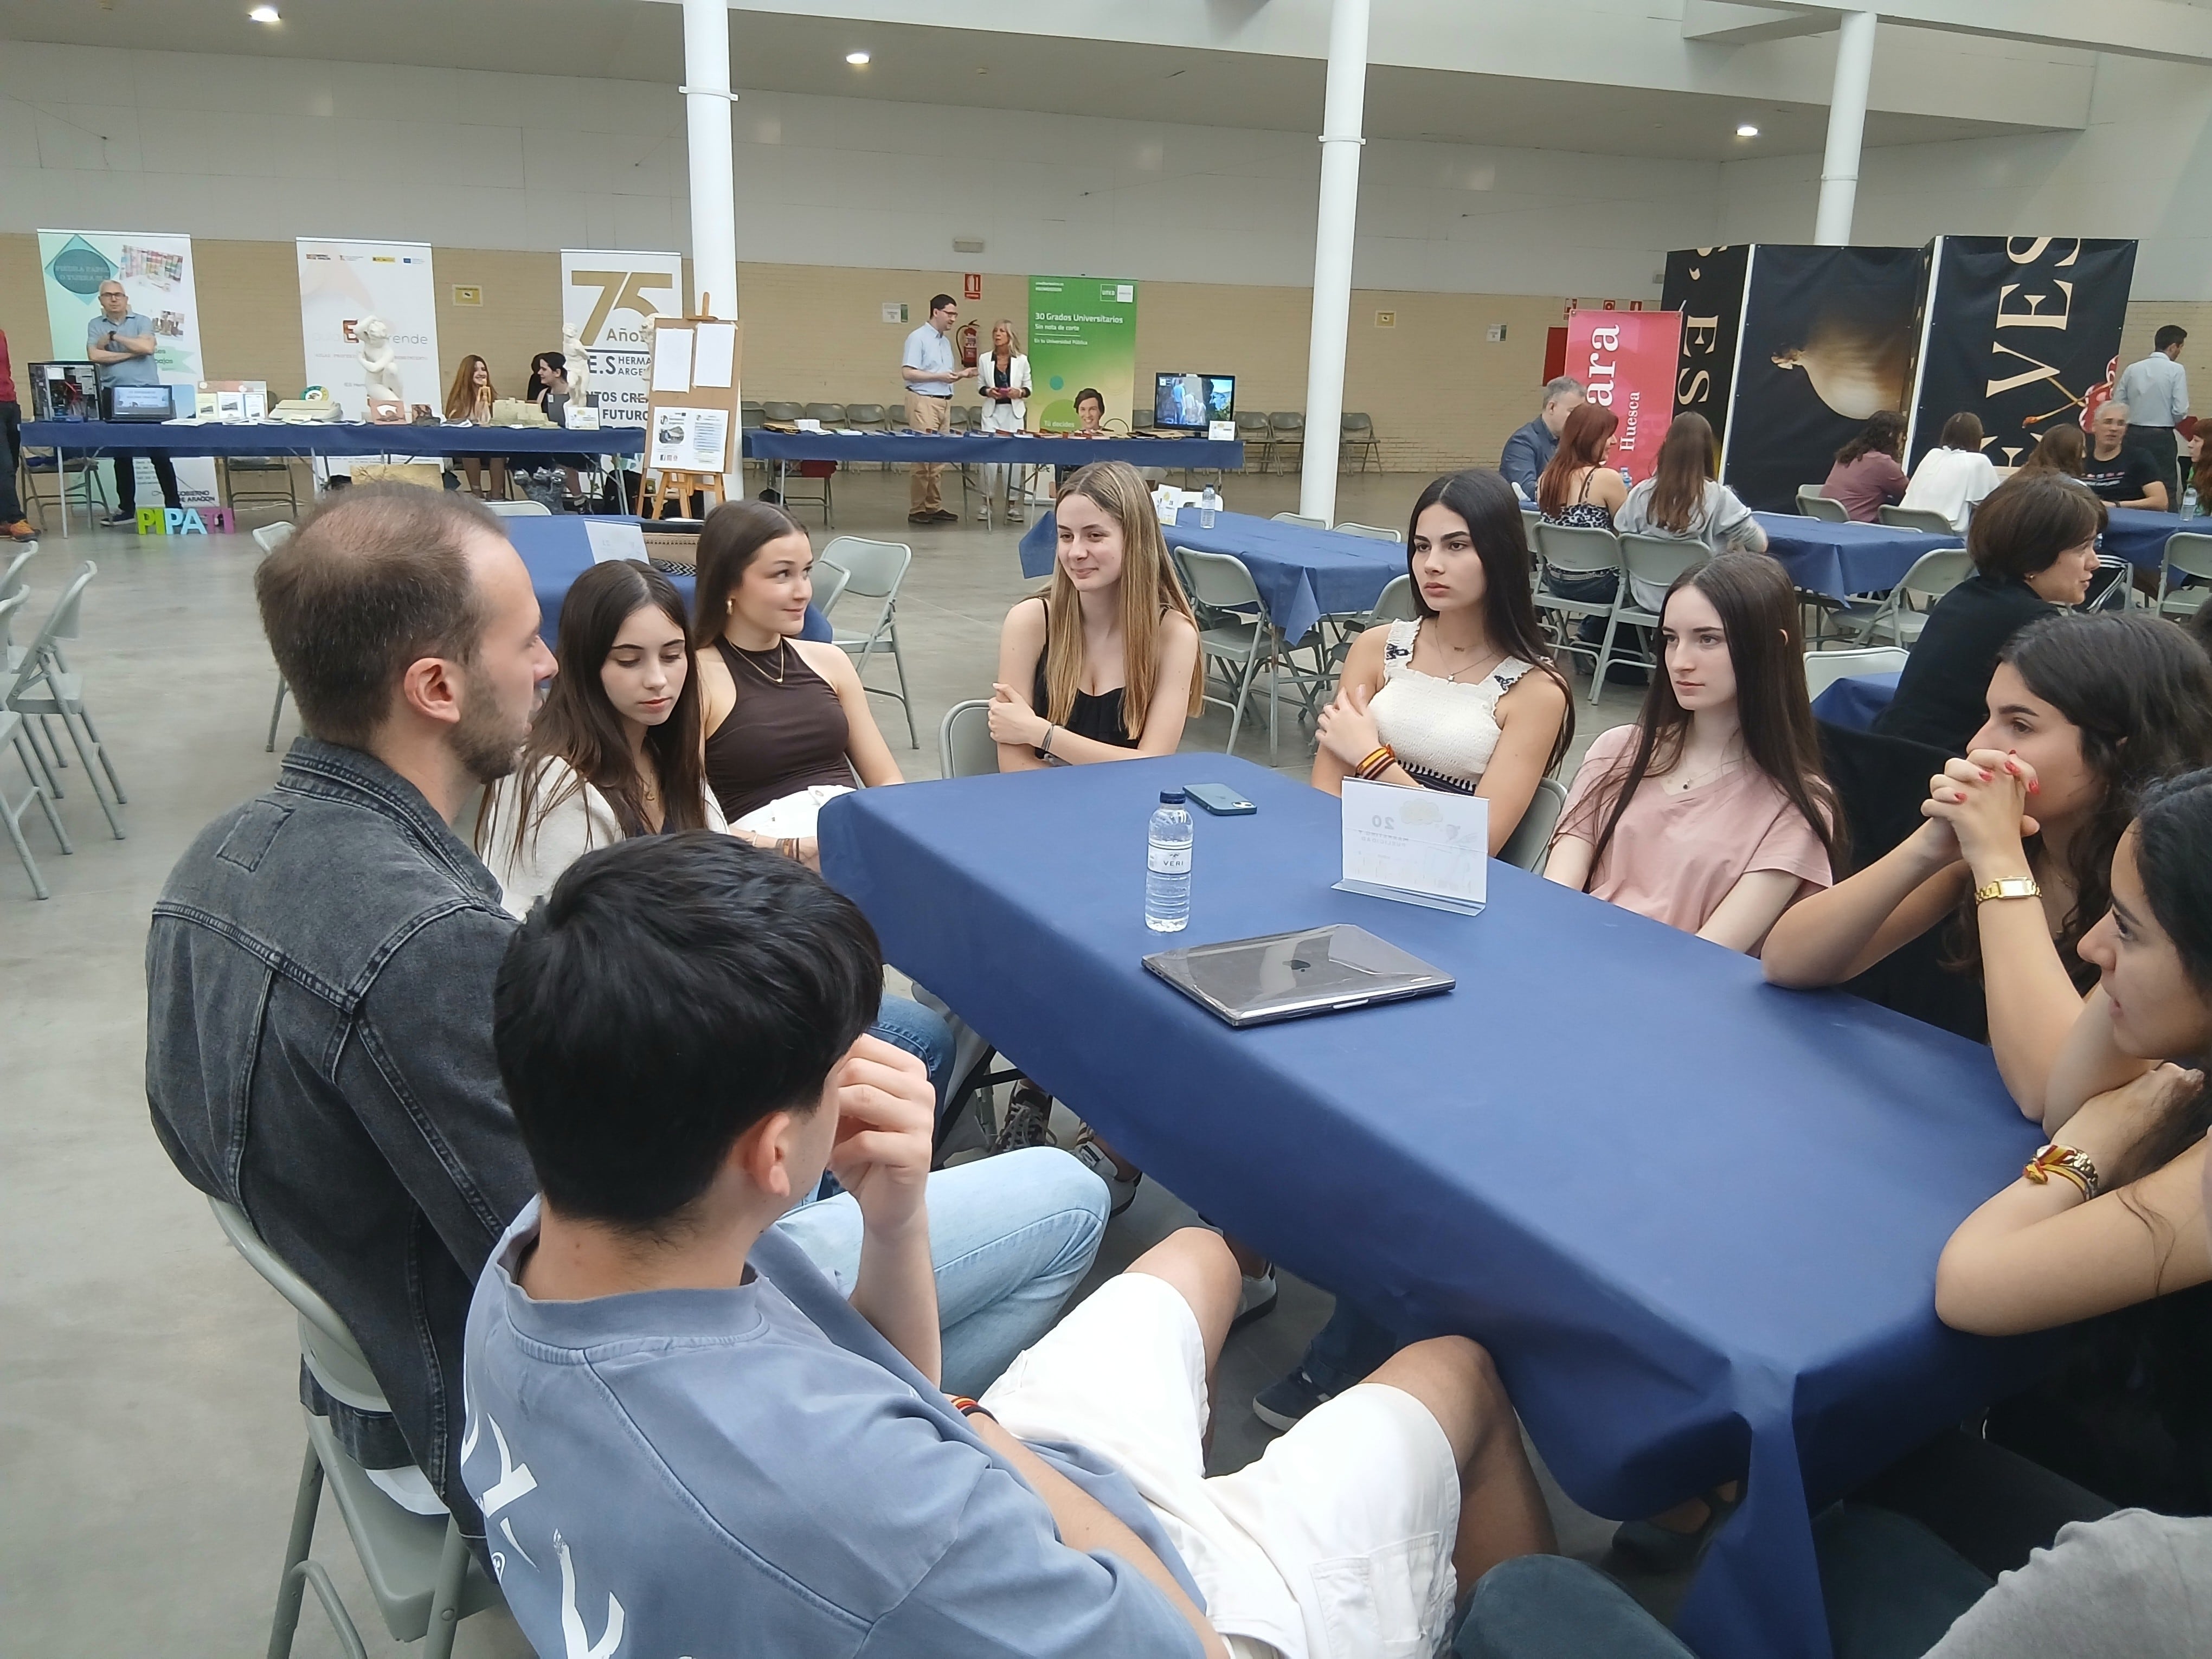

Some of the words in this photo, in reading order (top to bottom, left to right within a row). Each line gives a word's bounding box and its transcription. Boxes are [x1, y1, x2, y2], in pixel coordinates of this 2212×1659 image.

[571, 271, 672, 346] 75
[1046, 313, 1071, 321] Grados
[1073, 314, 1123, 323] Universitarios
[606, 327, 645, 342] Año
[1619, 391, 1640, 452] Huesca
